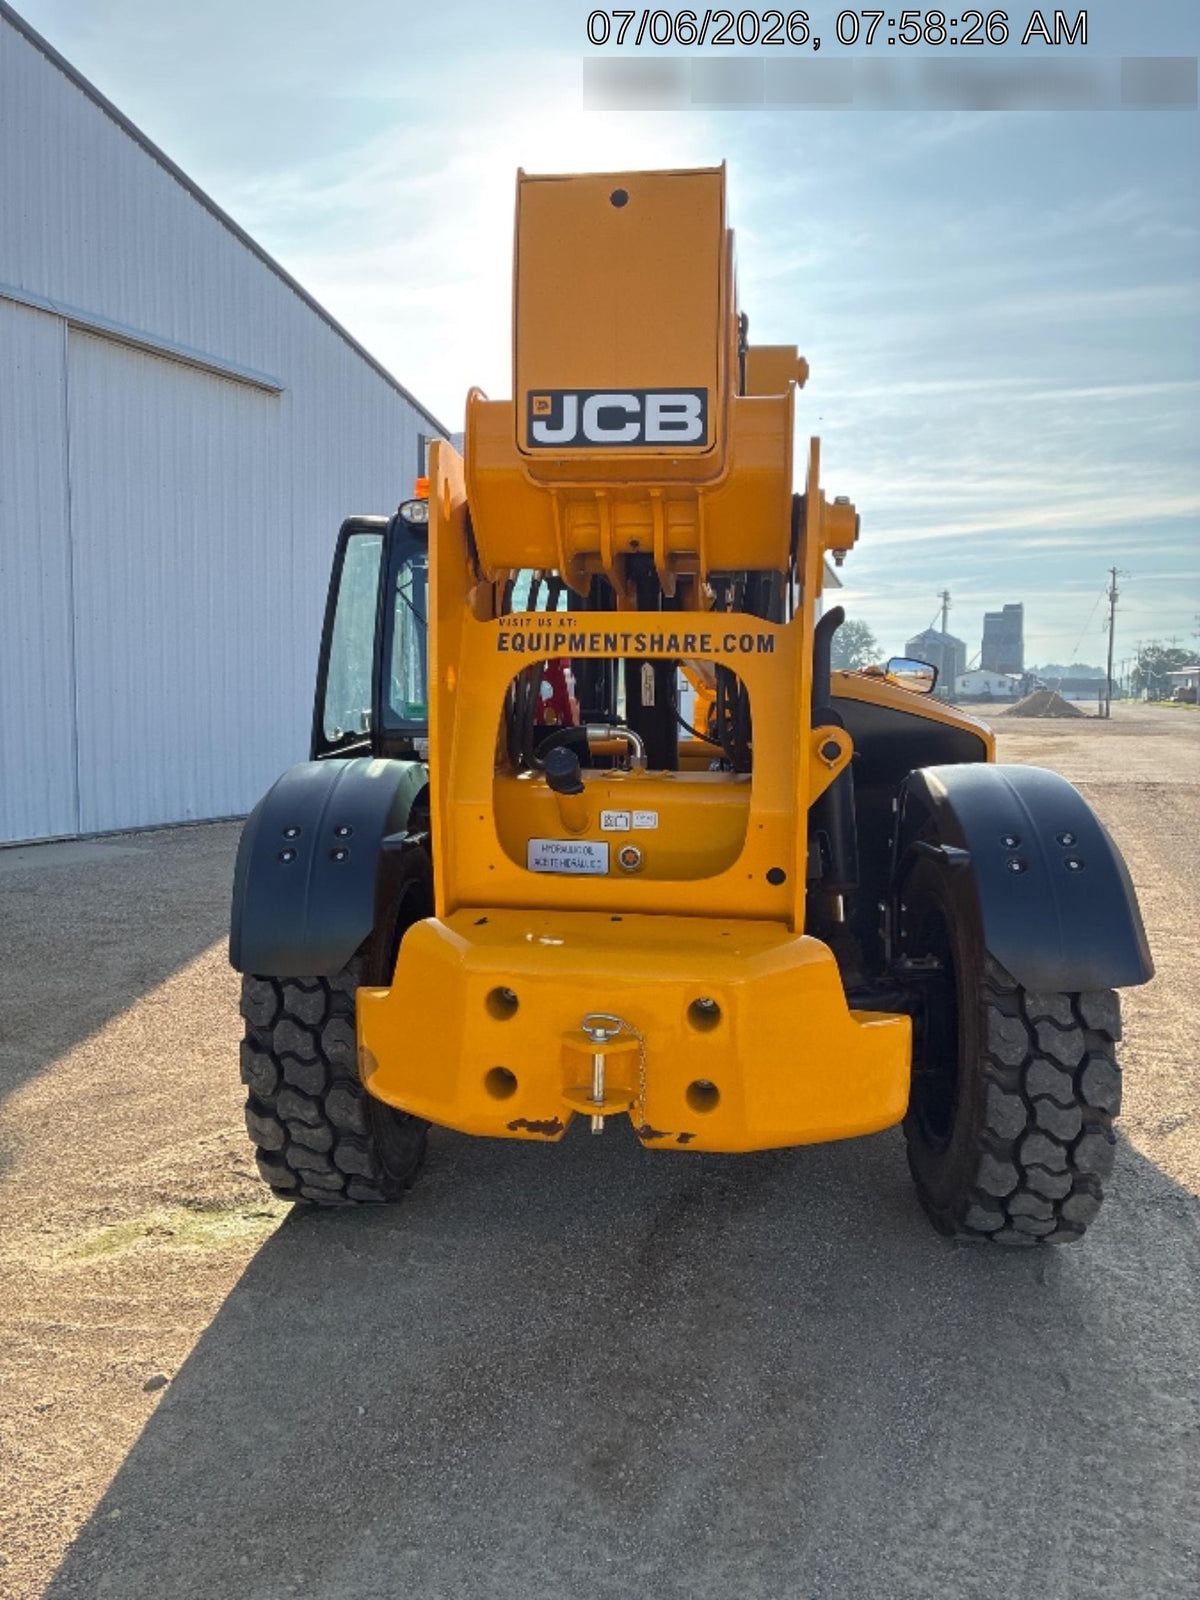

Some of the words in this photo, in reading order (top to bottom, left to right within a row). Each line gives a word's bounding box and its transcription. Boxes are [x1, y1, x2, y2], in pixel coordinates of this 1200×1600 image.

[532, 394, 703, 443] JCB
[499, 618, 532, 627] VISIT
[538, 618, 552, 627] US
[559, 618, 577, 627] AT:
[497, 632, 775, 653] EQUIPMENTSHARE.COM
